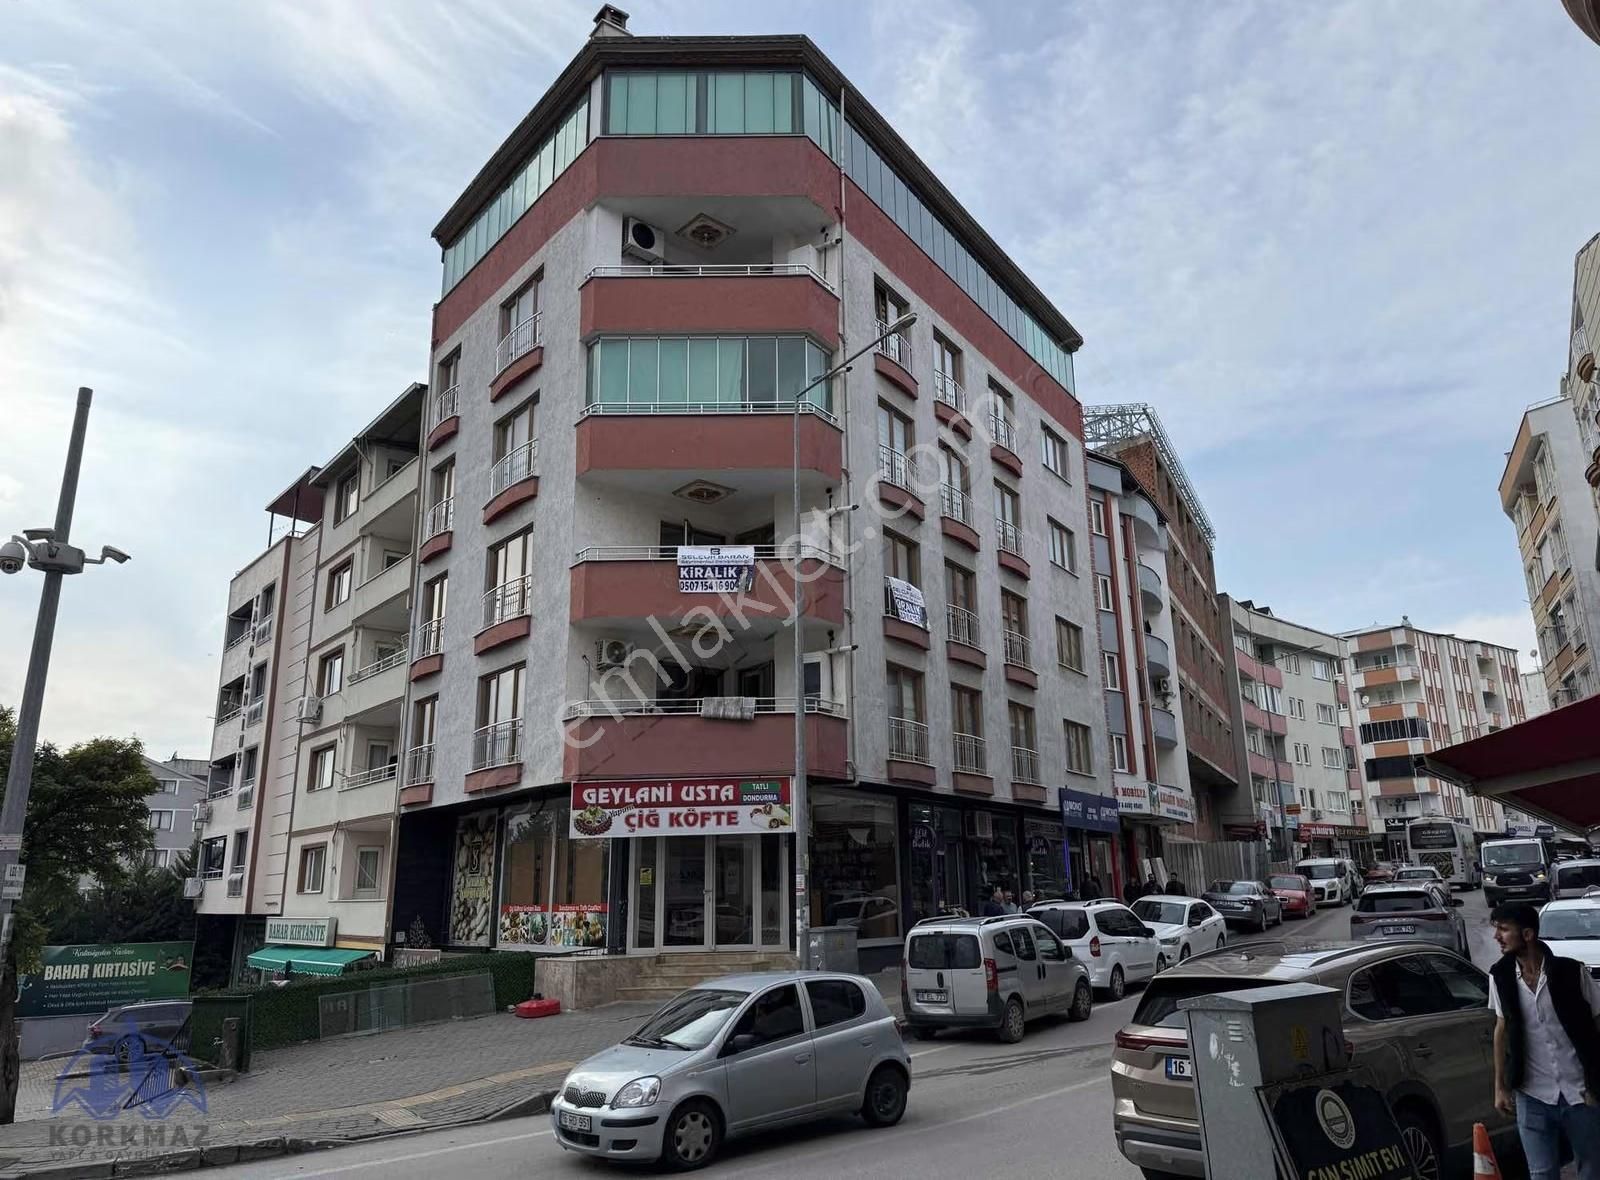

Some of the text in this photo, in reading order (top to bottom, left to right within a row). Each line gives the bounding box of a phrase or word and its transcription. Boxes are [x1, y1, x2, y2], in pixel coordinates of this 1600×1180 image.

[680, 566, 738, 579] KİRALIK
[582, 783, 734, 804] GEYLANİ USTA
[742, 794, 778, 802] DONDURMA
[624, 808, 739, 833] ÇİĞ KÖFTE
[268, 923, 289, 940] BAHAR
[44, 959, 156, 981] BAHAR KIRTASİYE
[1174, 1060, 1185, 1075] 16
[1340, 1151, 1383, 1180] SİMİT
